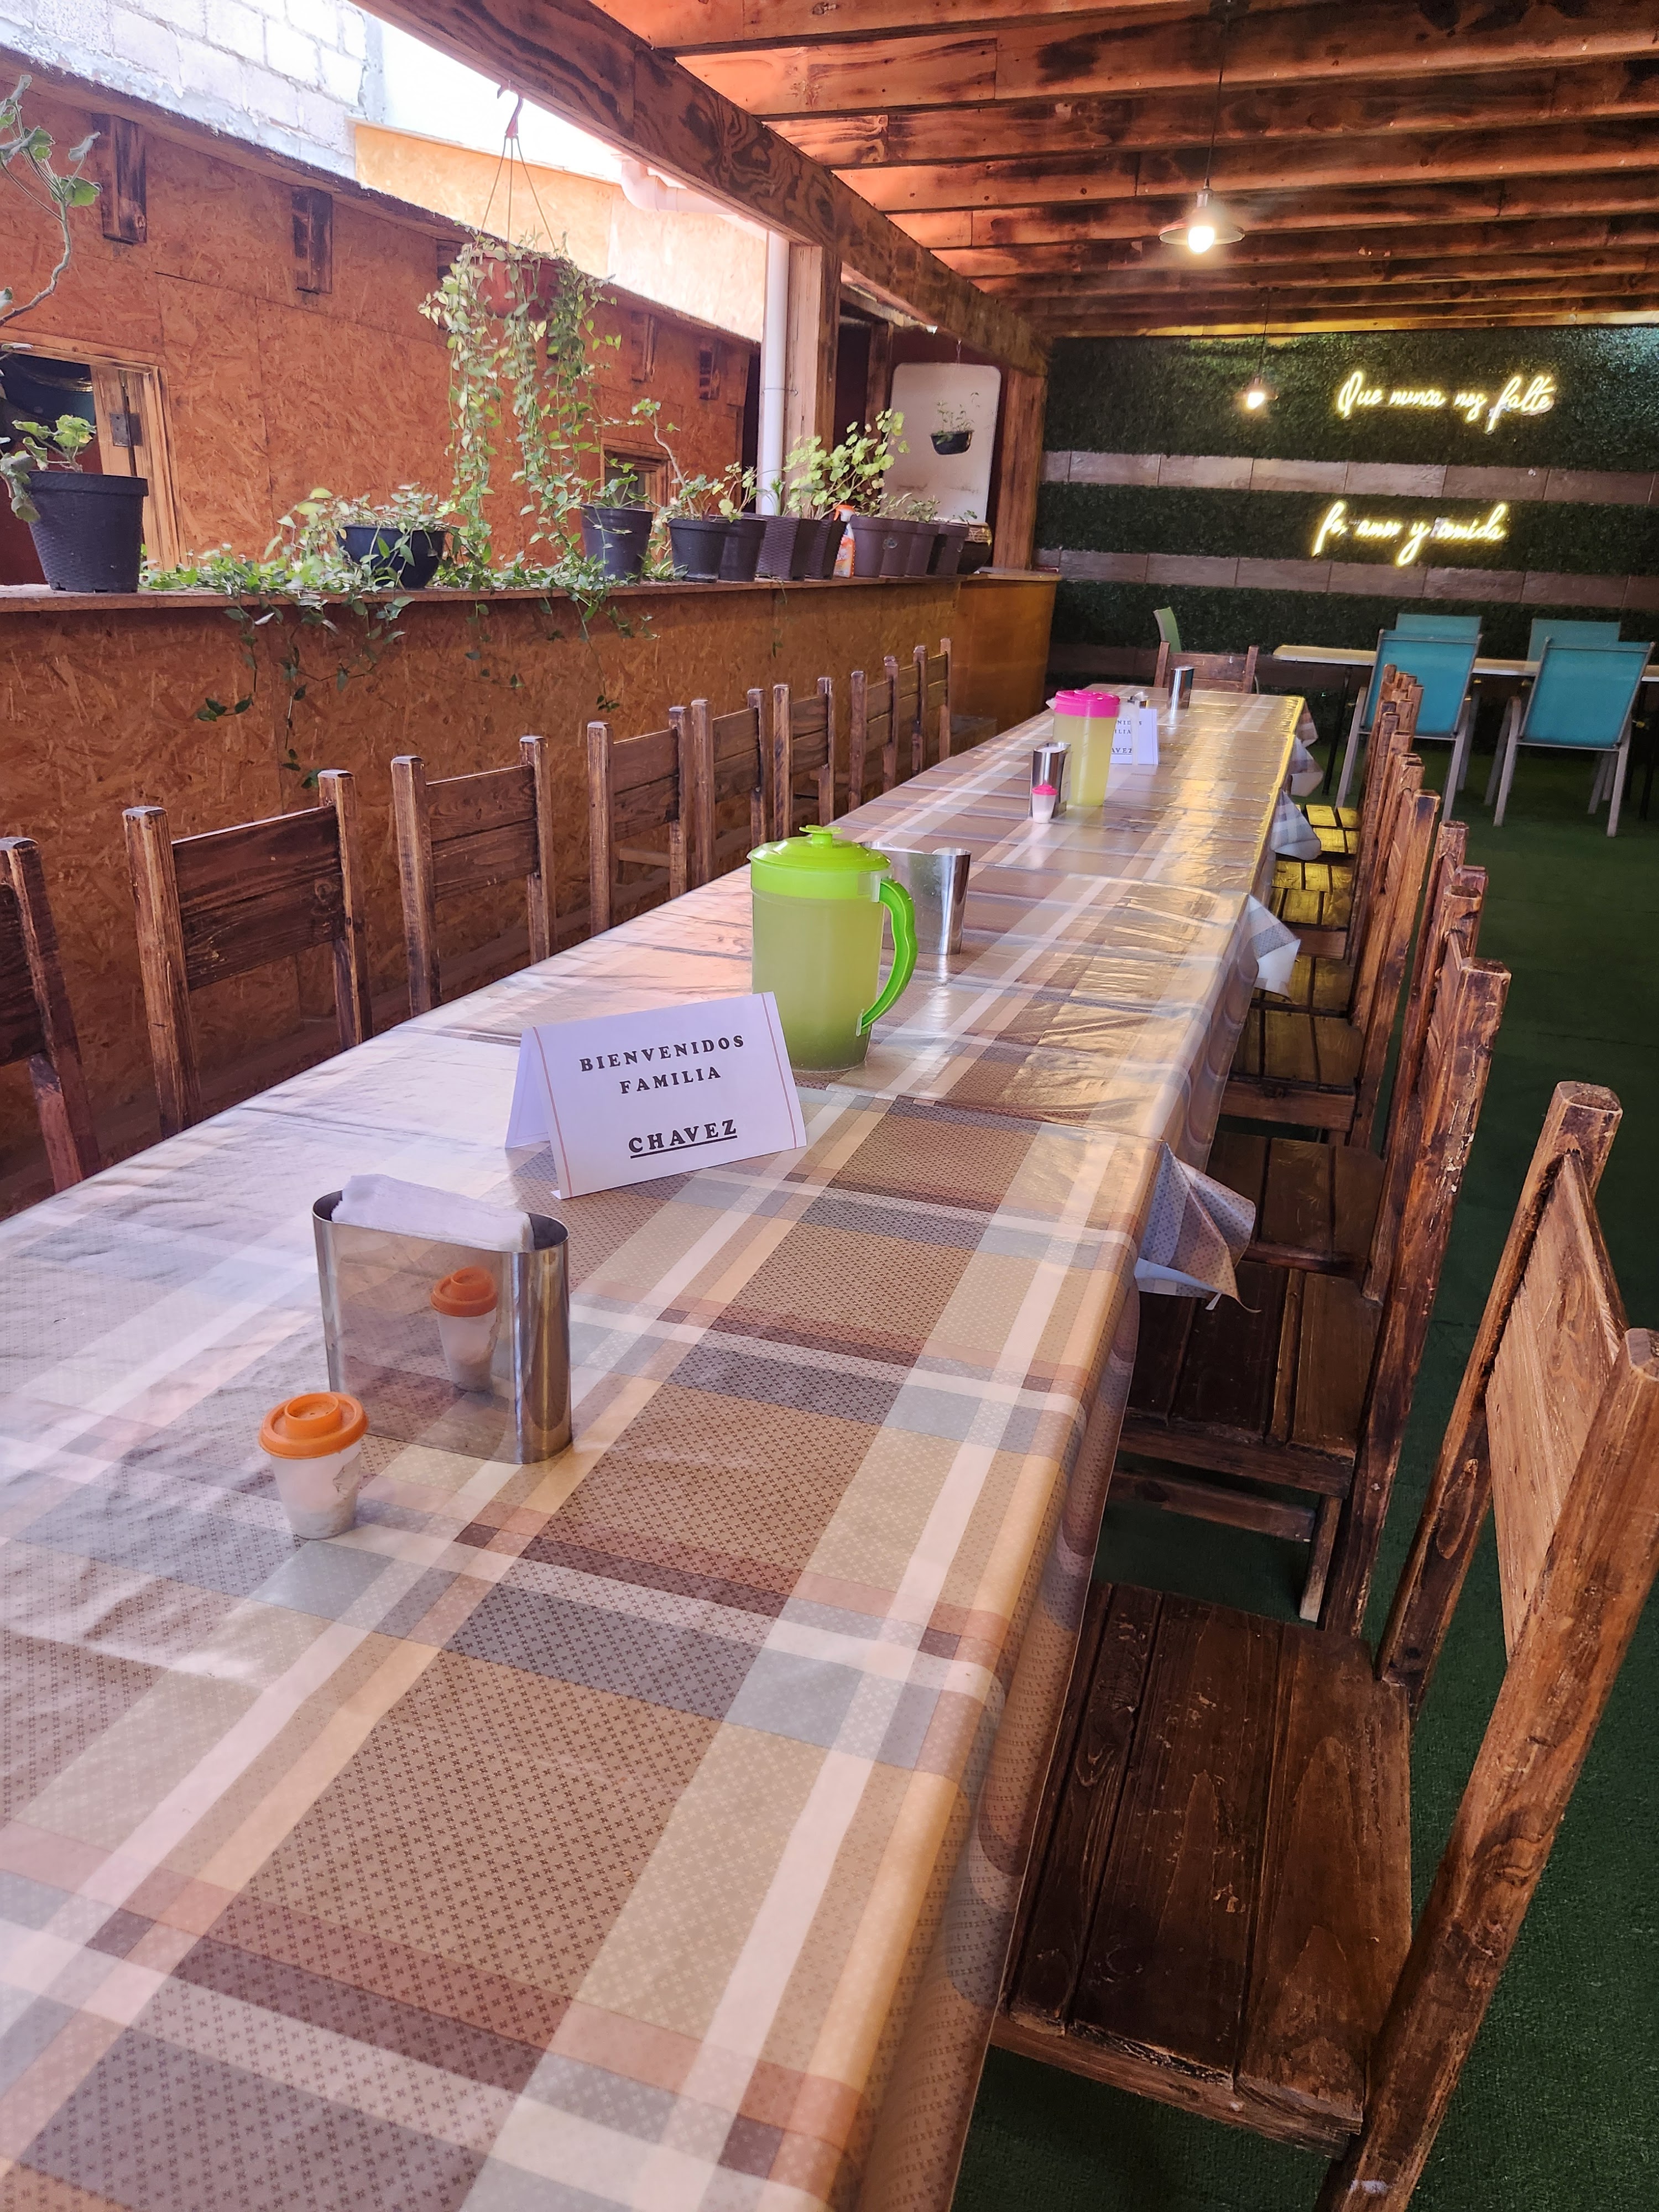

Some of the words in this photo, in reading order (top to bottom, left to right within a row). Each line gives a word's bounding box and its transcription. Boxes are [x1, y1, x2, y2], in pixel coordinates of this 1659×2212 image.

[1338, 371, 1383, 419] Que
[1388, 389, 1447, 408] nunca
[1485, 375, 1555, 435] falte
[1396, 521, 1432, 567] y
[579, 1035, 744, 1072] BIENVENIDOS
[619, 1066, 721, 1094] FAMILIA
[628, 1119, 737, 1153] CHAVEZ
